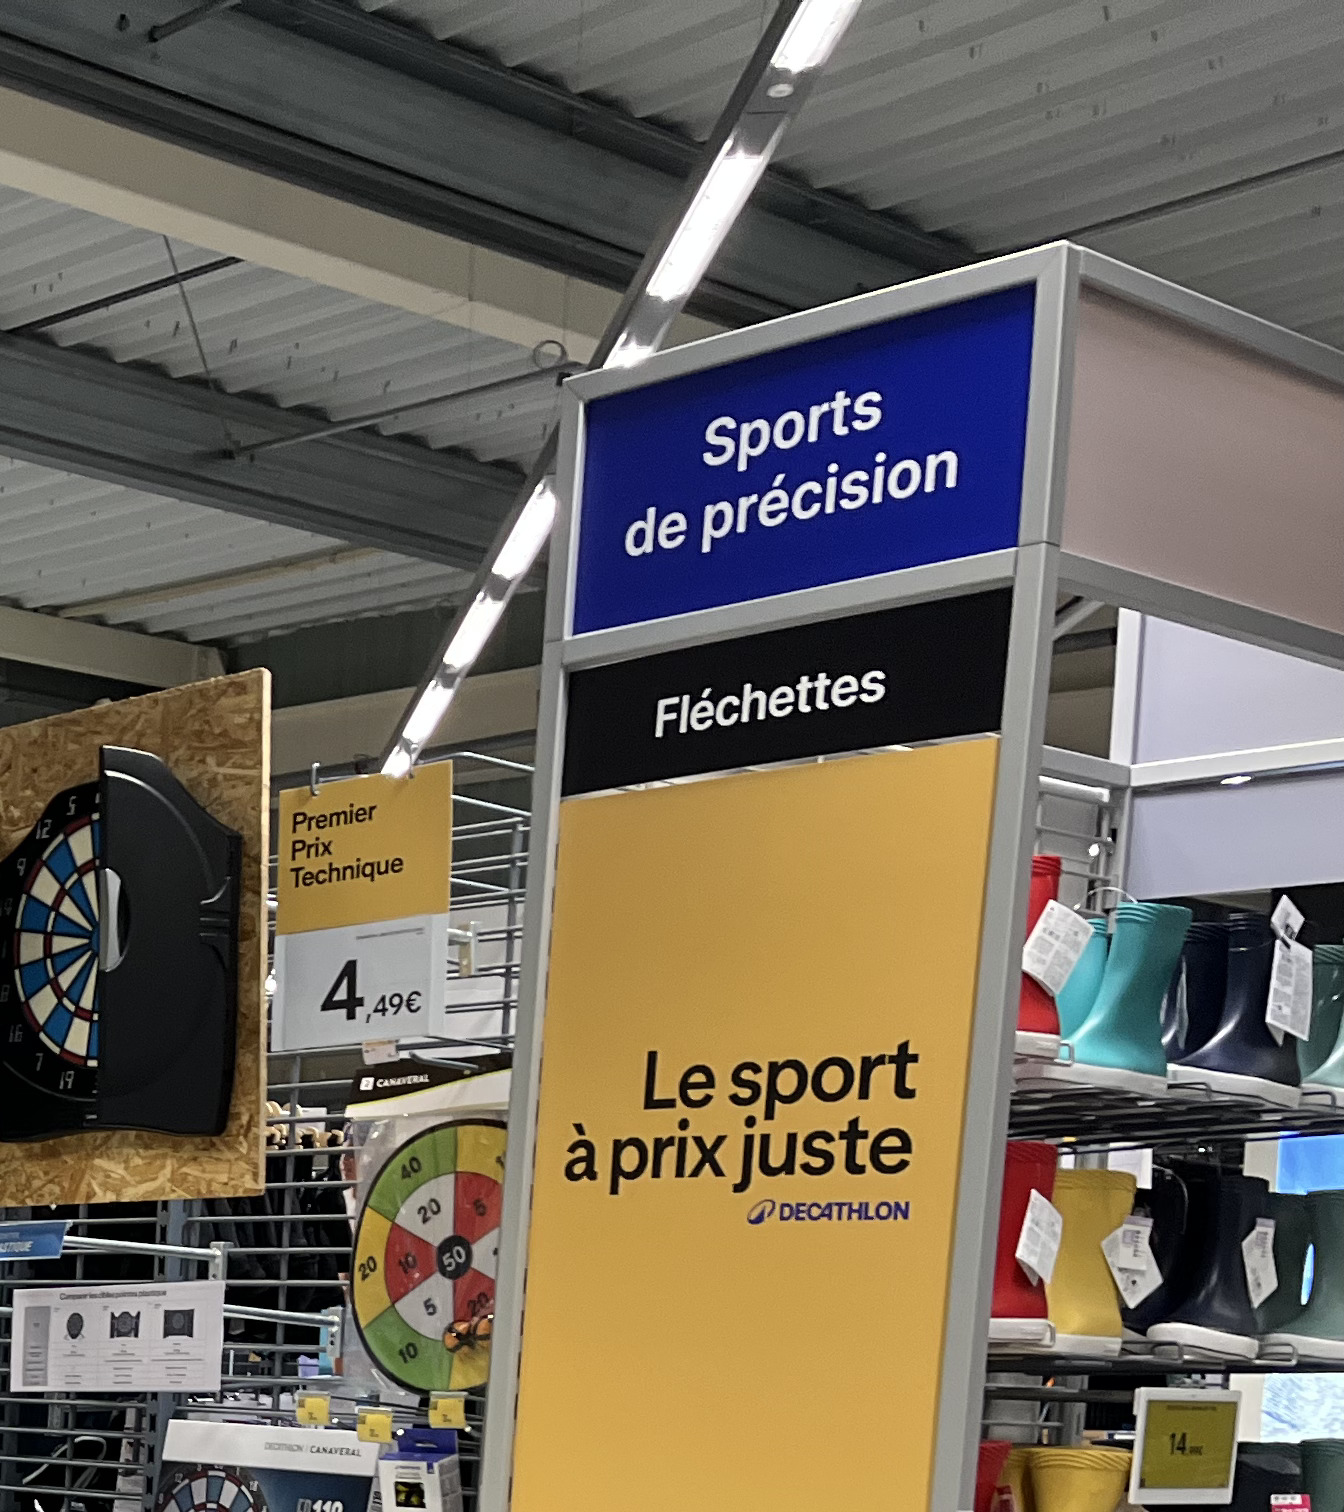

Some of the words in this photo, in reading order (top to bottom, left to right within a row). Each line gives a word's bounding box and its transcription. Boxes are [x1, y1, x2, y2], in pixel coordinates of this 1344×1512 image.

[702, 389, 883, 471] Sports
[624, 506, 688, 557] de
[700, 449, 959, 552] précision
[654, 668, 886, 738] Fléchettes
[36, 820, 52, 840] 12
[291, 803, 377, 834] Premier
[290, 837, 333, 862] Prix
[289, 855, 404, 889] Technique
[376, 1074, 430, 1088] CANAVERAL
[642, 1049, 715, 1110] Le
[728, 1039, 919, 1121] sport
[564, 1122, 598, 1182] à
[608, 1117, 727, 1195] prix
[731, 1114, 913, 1193] juste
[400, 1156, 422, 1181] 40
[417, 1198, 441, 1224] 20
[778, 1200, 910, 1222] DECATHLON
[358, 1255, 378, 1281] 20
[399, 1252, 417, 1274] 10
[442, 1244, 467, 1271] 50
[424, 1297, 437, 1316] 5
[398, 1341, 419, 1364] 10
[309, 1445, 362, 1457] CANAVERAL
